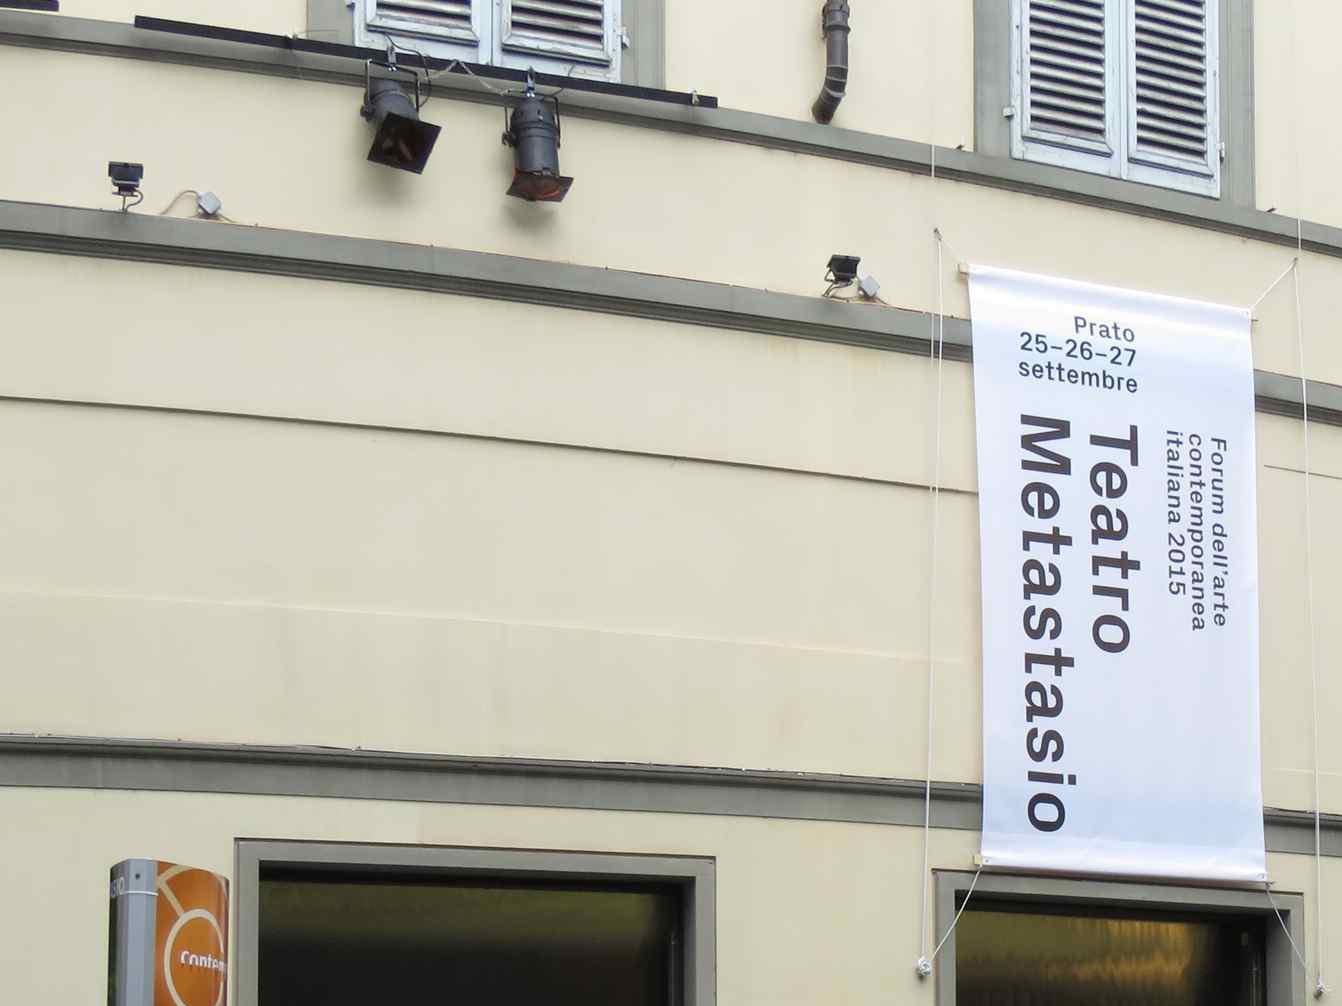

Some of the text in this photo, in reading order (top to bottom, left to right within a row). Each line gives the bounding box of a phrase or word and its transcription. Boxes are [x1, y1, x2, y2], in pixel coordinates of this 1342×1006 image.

[1019, 361, 1138, 393] settembre
[1074, 316, 1135, 342] Prato
[1089, 424, 1141, 653] Teatro
[1167, 429, 1186, 596] italiana 2015
[1187, 434, 1206, 631] contemporanea
[1211, 437, 1229, 627] Forum dell'arte
[1020, 414, 1077, 832] Metastasio
